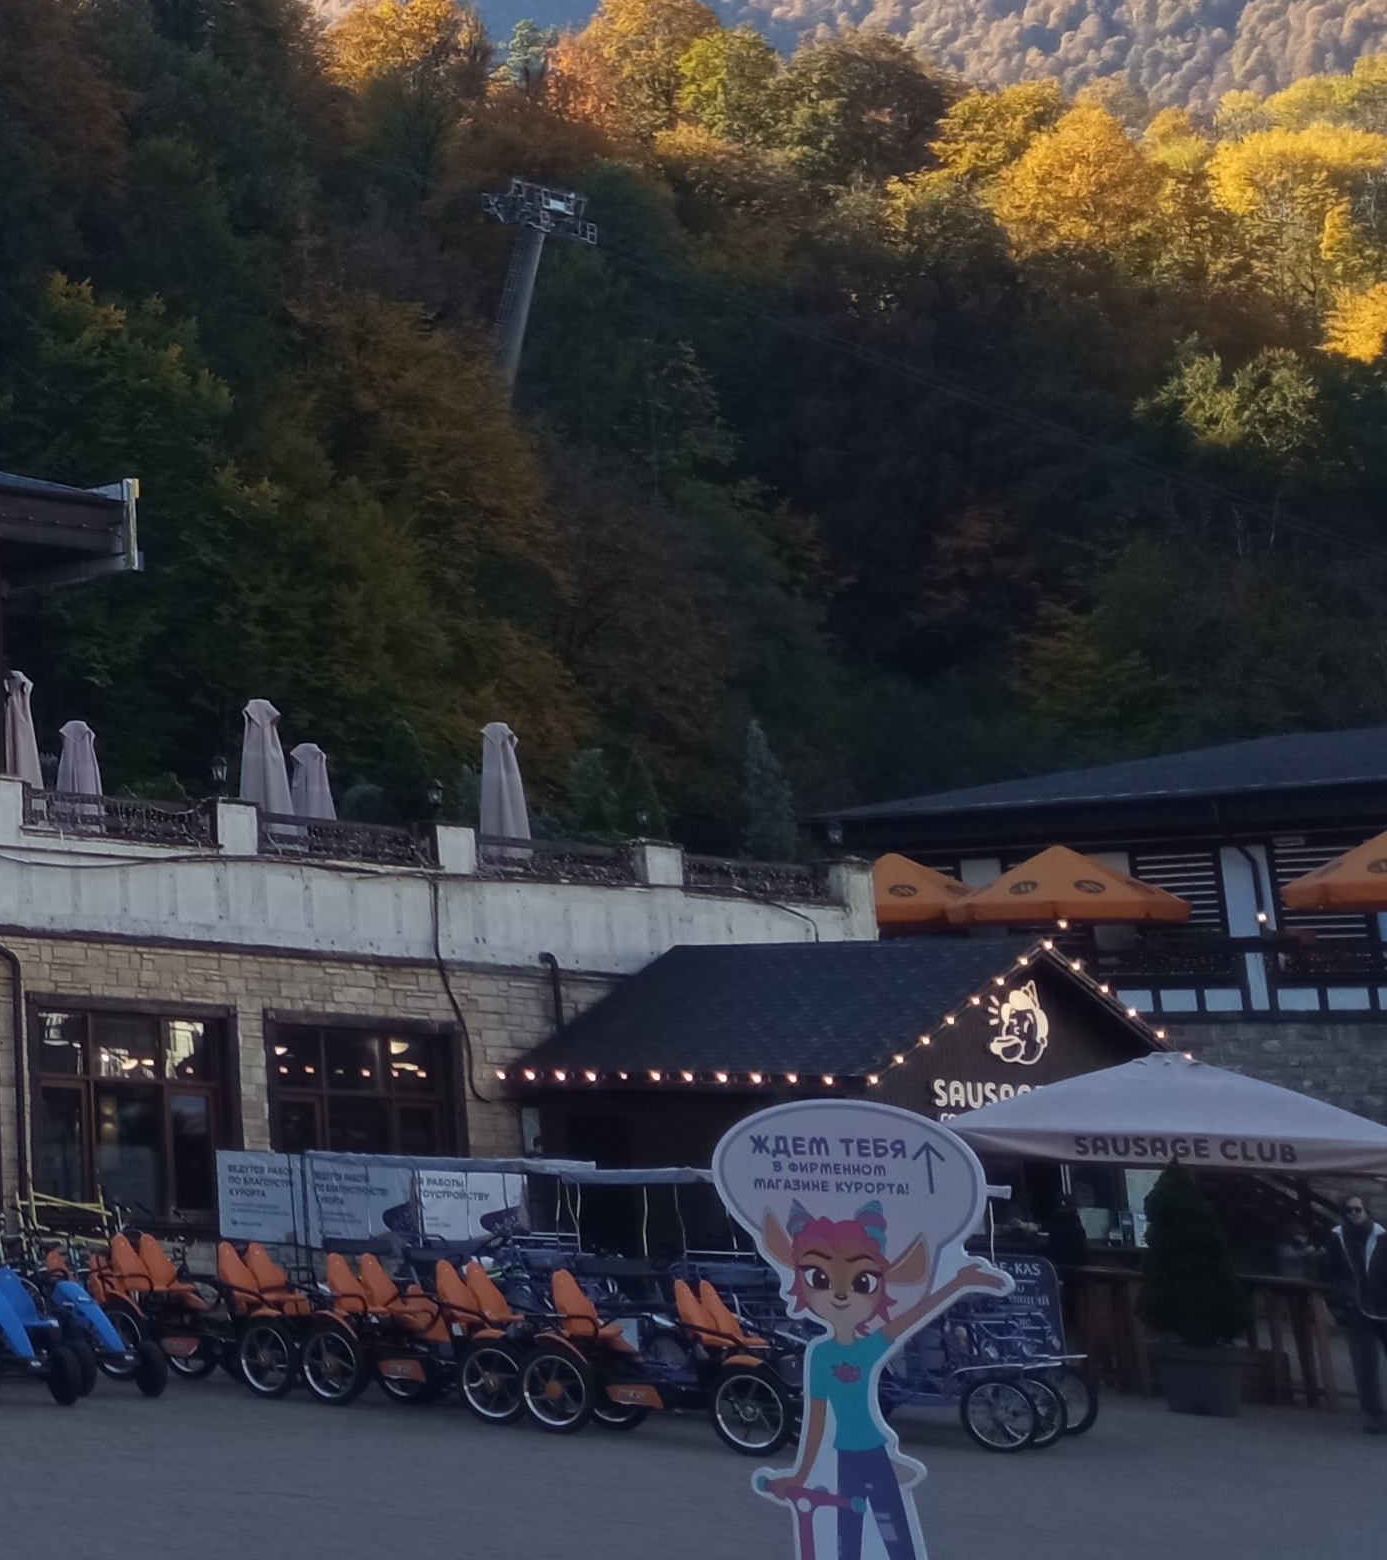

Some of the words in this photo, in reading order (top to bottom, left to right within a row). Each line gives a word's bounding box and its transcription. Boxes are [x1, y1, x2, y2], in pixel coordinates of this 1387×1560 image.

[933, 1078, 1045, 1109] SAUSA
[750, 1135, 830, 1158] ЖДЕМ
[839, 1137, 907, 1160] ТЕБЯ
[1074, 1135, 1210, 1160] SAUSAGE
[1220, 1139, 1298, 1164] CLUB
[228, 1164, 265, 1175] ВЕДУТСЯ
[772, 1161, 783, 1172] В
[788, 1162, 887, 1177] ФИРМЕННОМ
[229, 1176, 241, 1185] ПО
[427, 1178, 464, 1188] РАБОТЫ
[754, 1177, 830, 1193] МАГАЗИНЕ
[835, 1181, 910, 1195] КУРОРТА!
[229, 1187, 267, 1198] КУРОРТА
